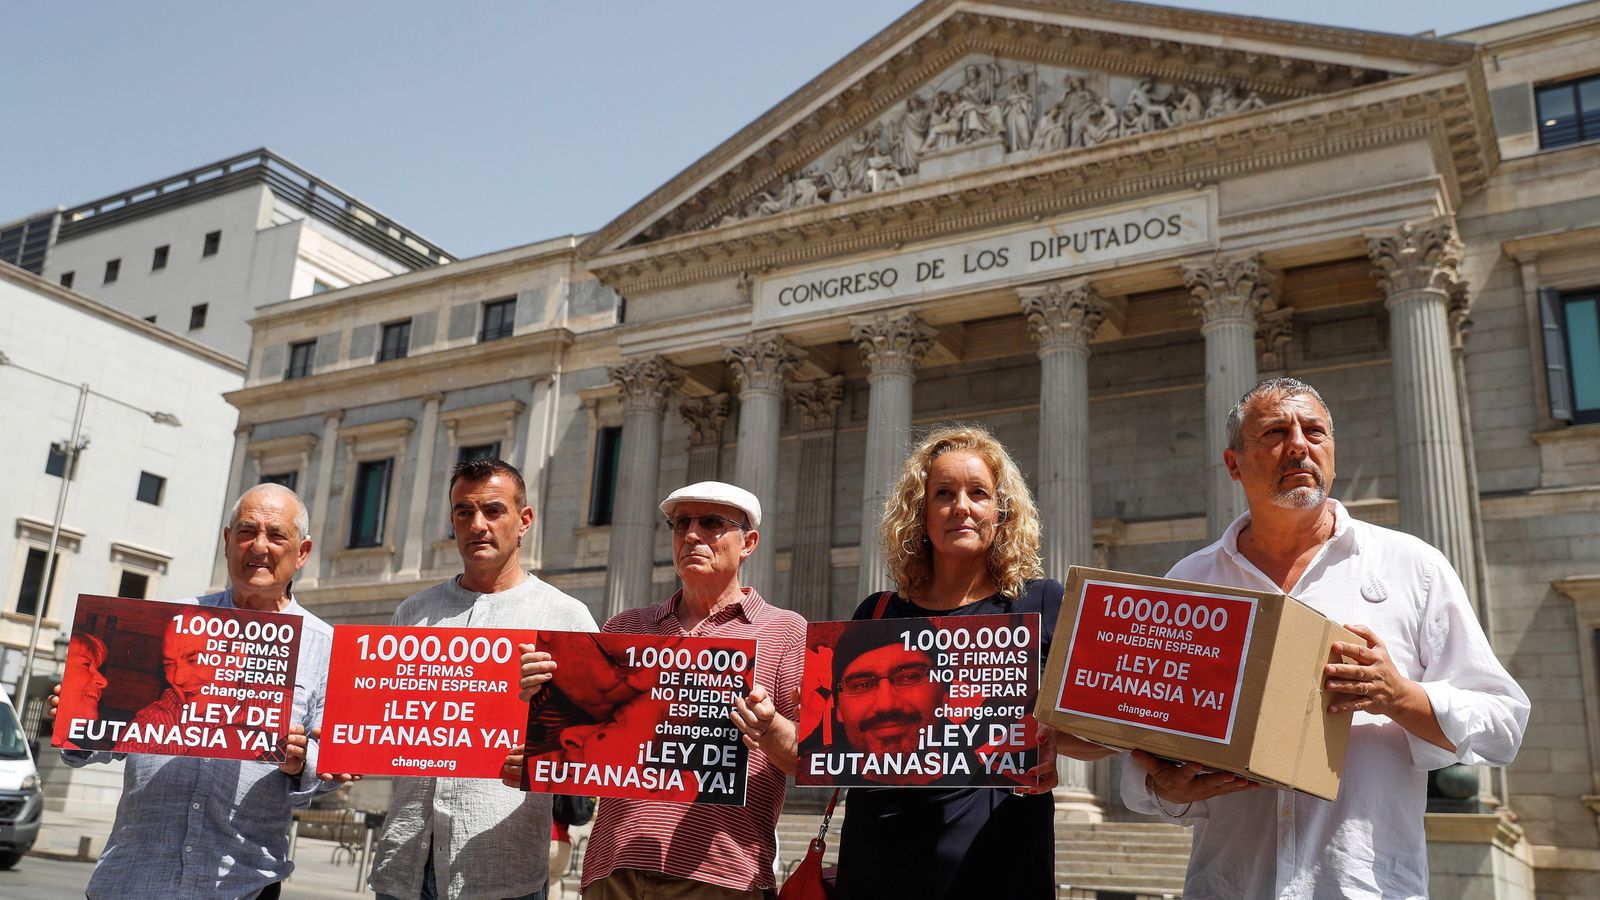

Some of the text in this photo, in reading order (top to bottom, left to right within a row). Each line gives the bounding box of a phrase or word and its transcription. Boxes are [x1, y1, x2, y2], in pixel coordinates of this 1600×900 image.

[778, 214, 1182, 307] CONGRESO DE LOS DIPUTADOS
[1103, 594, 1228, 632] 1.000.000
[172, 615, 294, 643] 1.000.000
[900, 626, 1030, 651] 1.000.000
[1131, 623, 1193, 641] DE FIRMAS
[206, 639, 289, 657] DE FIRMAS
[357, 634, 513, 663] 1.000.000
[1097, 631, 1220, 658] NO PUEDEN ESPERAR
[197, 653, 288, 672] NO PUEDEN
[626, 646, 747, 672] 1.000.000
[938, 651, 1028, 666] DE FIRMAS
[1116, 654, 1190, 680] ¡LEY DE
[215, 669, 286, 685] ESPERAR
[396, 664, 473, 677] DE FIRMAS
[659, 672, 743, 688] DE FIRMAS
[929, 667, 1027, 682] NO PUEDEN
[201, 683, 283, 703] change.org
[355, 678, 507, 693] NO PUEDEN ESPERAR
[651, 687, 742, 704] NO PUEDEN
[950, 684, 1027, 698] ESPERAR
[1075, 669, 1224, 710] EUTANASIA YA!
[181, 702, 280, 727] ¡LEY DE
[384, 700, 475, 721] ¡LEY DE
[935, 704, 1024, 720] change.org
[1118, 703, 1169, 721] change.org
[69, 718, 278, 751] EUTANASIA YA!
[332, 725, 519, 749] EUTANASIA YA!
[656, 721, 738, 740] change.org
[919, 724, 1025, 750] ¡LEY DE
[392, 756, 456, 770] change.org
[638, 741, 737, 767] ¡LEY DE
[810, 752, 1025, 775] EUTANASIA YA!
[534, 760, 735, 794] EUTANASIA YA!
